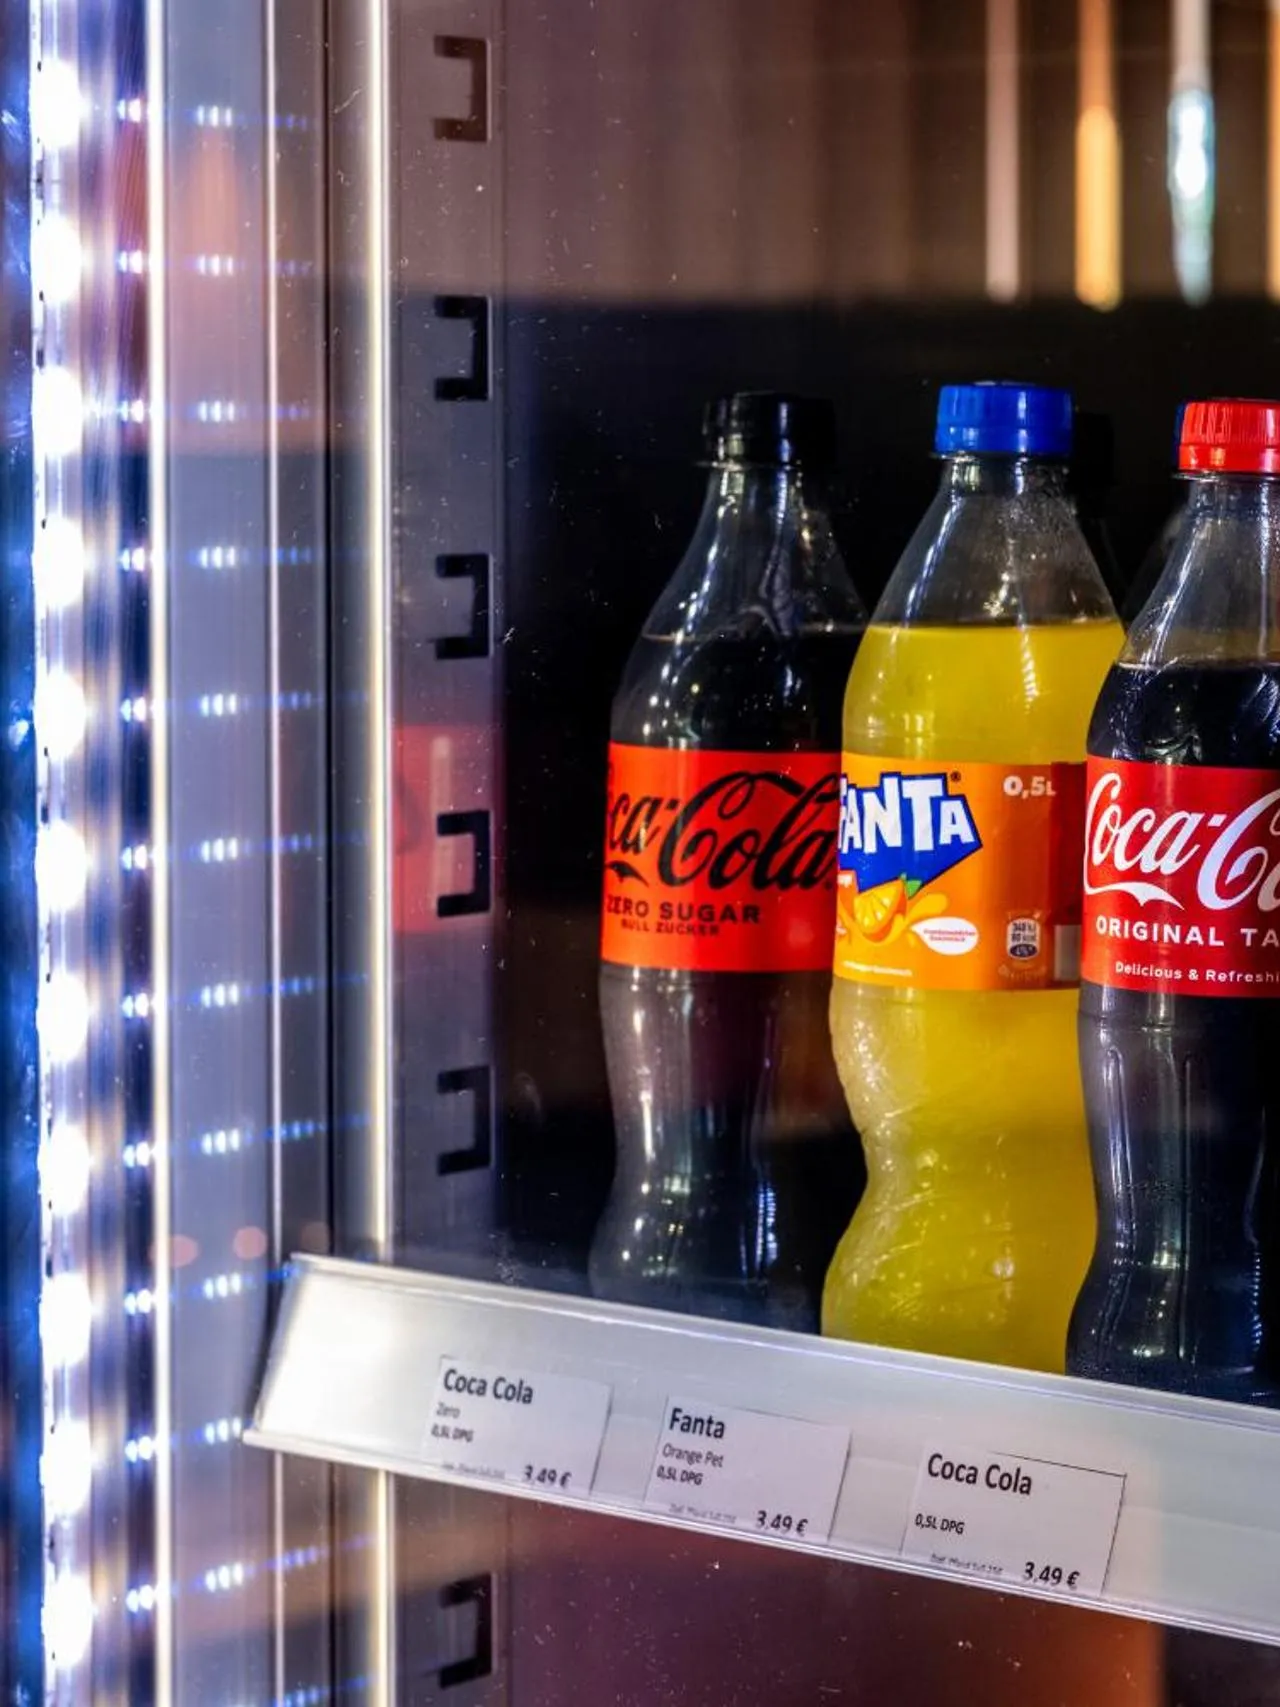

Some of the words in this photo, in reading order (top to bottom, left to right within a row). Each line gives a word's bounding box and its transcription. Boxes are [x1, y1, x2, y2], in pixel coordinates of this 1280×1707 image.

[608, 894, 650, 916] ZERO
[659, 901, 761, 924] SUGAR
[1095, 914, 1225, 948] ORIGINAL
[1115, 960, 1182, 980] Delicious
[1188, 969, 1199, 982] &
[444, 1368, 488, 1397] Coca
[493, 1376, 534, 1405] Cola
[669, 1407, 726, 1439] Fanta
[662, 1442, 703, 1466] Orange
[705, 1450, 724, 1467] Pet
[524, 1465, 557, 1485] 3,49
[680, 1469, 704, 1486] DPG
[927, 1453, 978, 1485] Coca
[985, 1464, 1033, 1496] Cola
[755, 1510, 793, 1532] 3,49
[795, 1518, 809, 1535] €
[915, 1513, 938, 1530] 0,5L
[940, 1518, 965, 1535] DPG
[1022, 1561, 1063, 1585] 3,49
[1066, 1570, 1080, 1588] €
